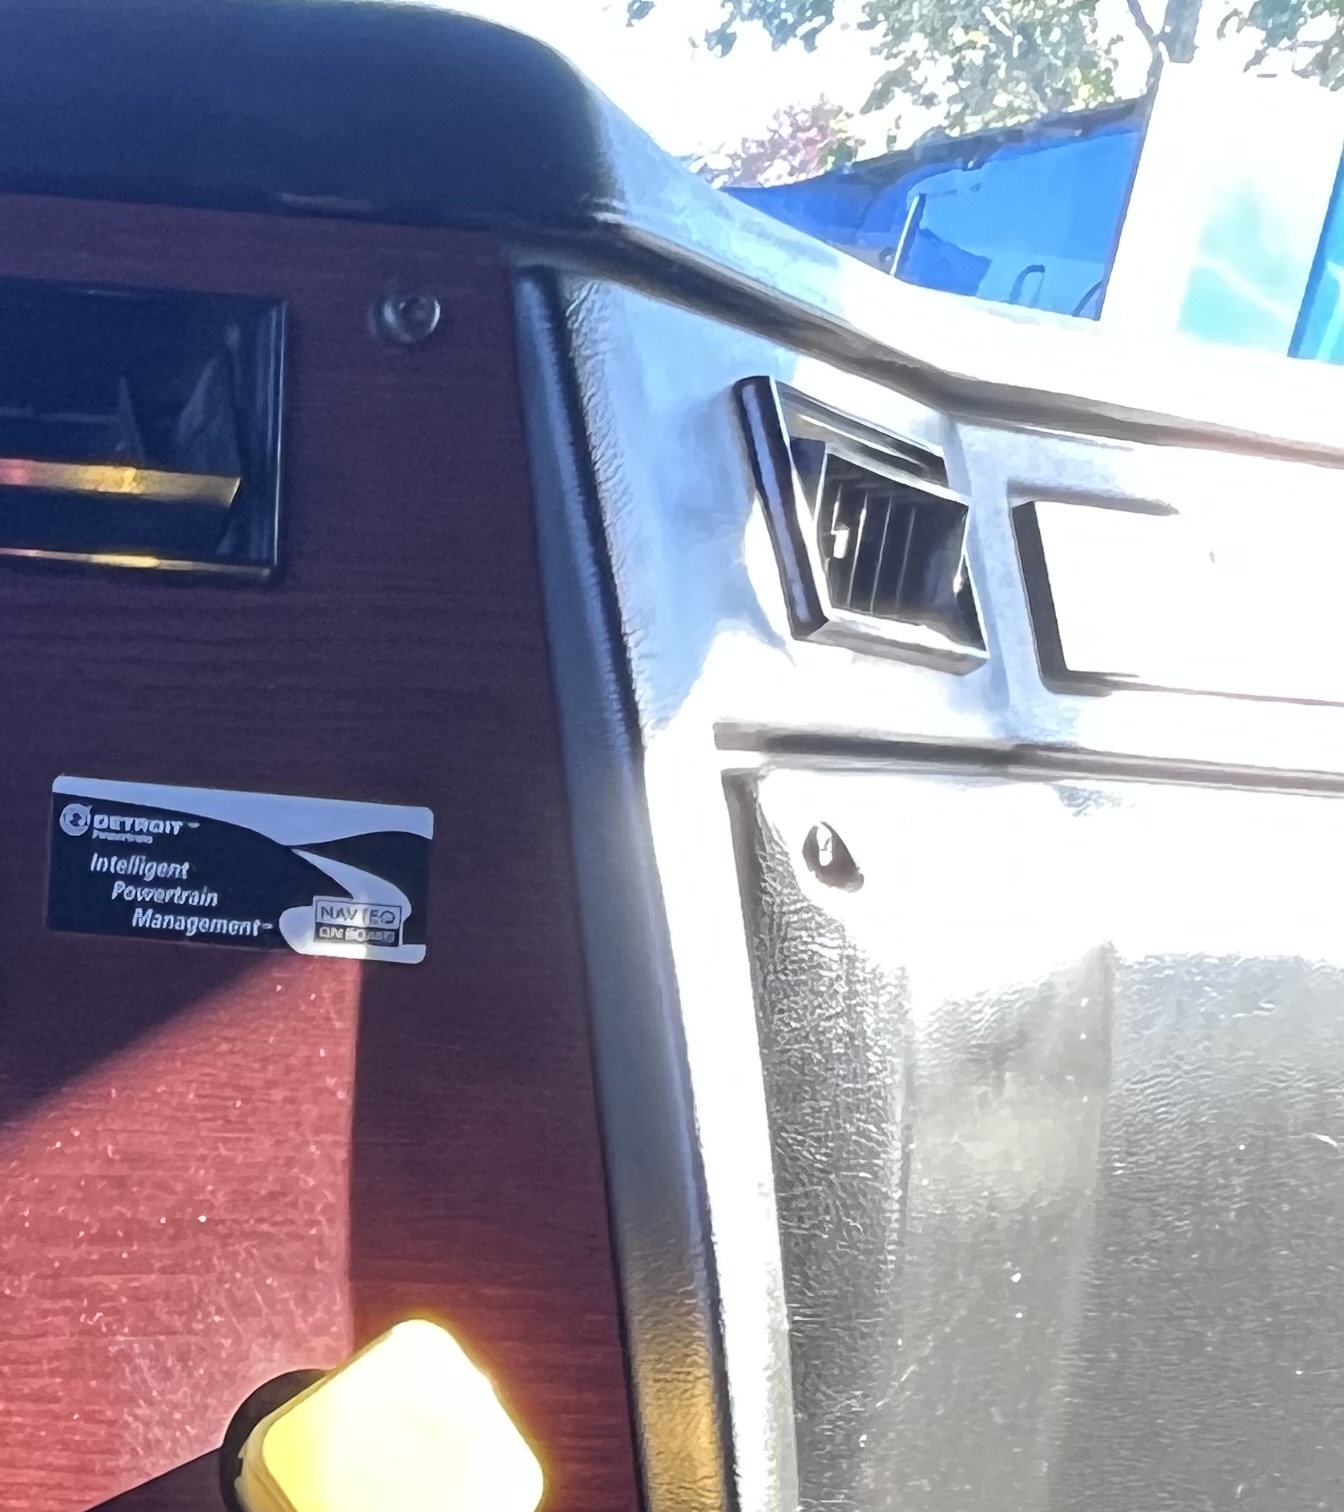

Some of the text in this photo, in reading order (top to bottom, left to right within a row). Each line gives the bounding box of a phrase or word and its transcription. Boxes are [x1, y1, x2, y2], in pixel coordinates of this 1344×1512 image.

[93, 814, 184, 836] DETROIT
[90, 853, 190, 882] Intelligent
[112, 880, 218, 907] Powertrain
[132, 907, 261, 937] Management
